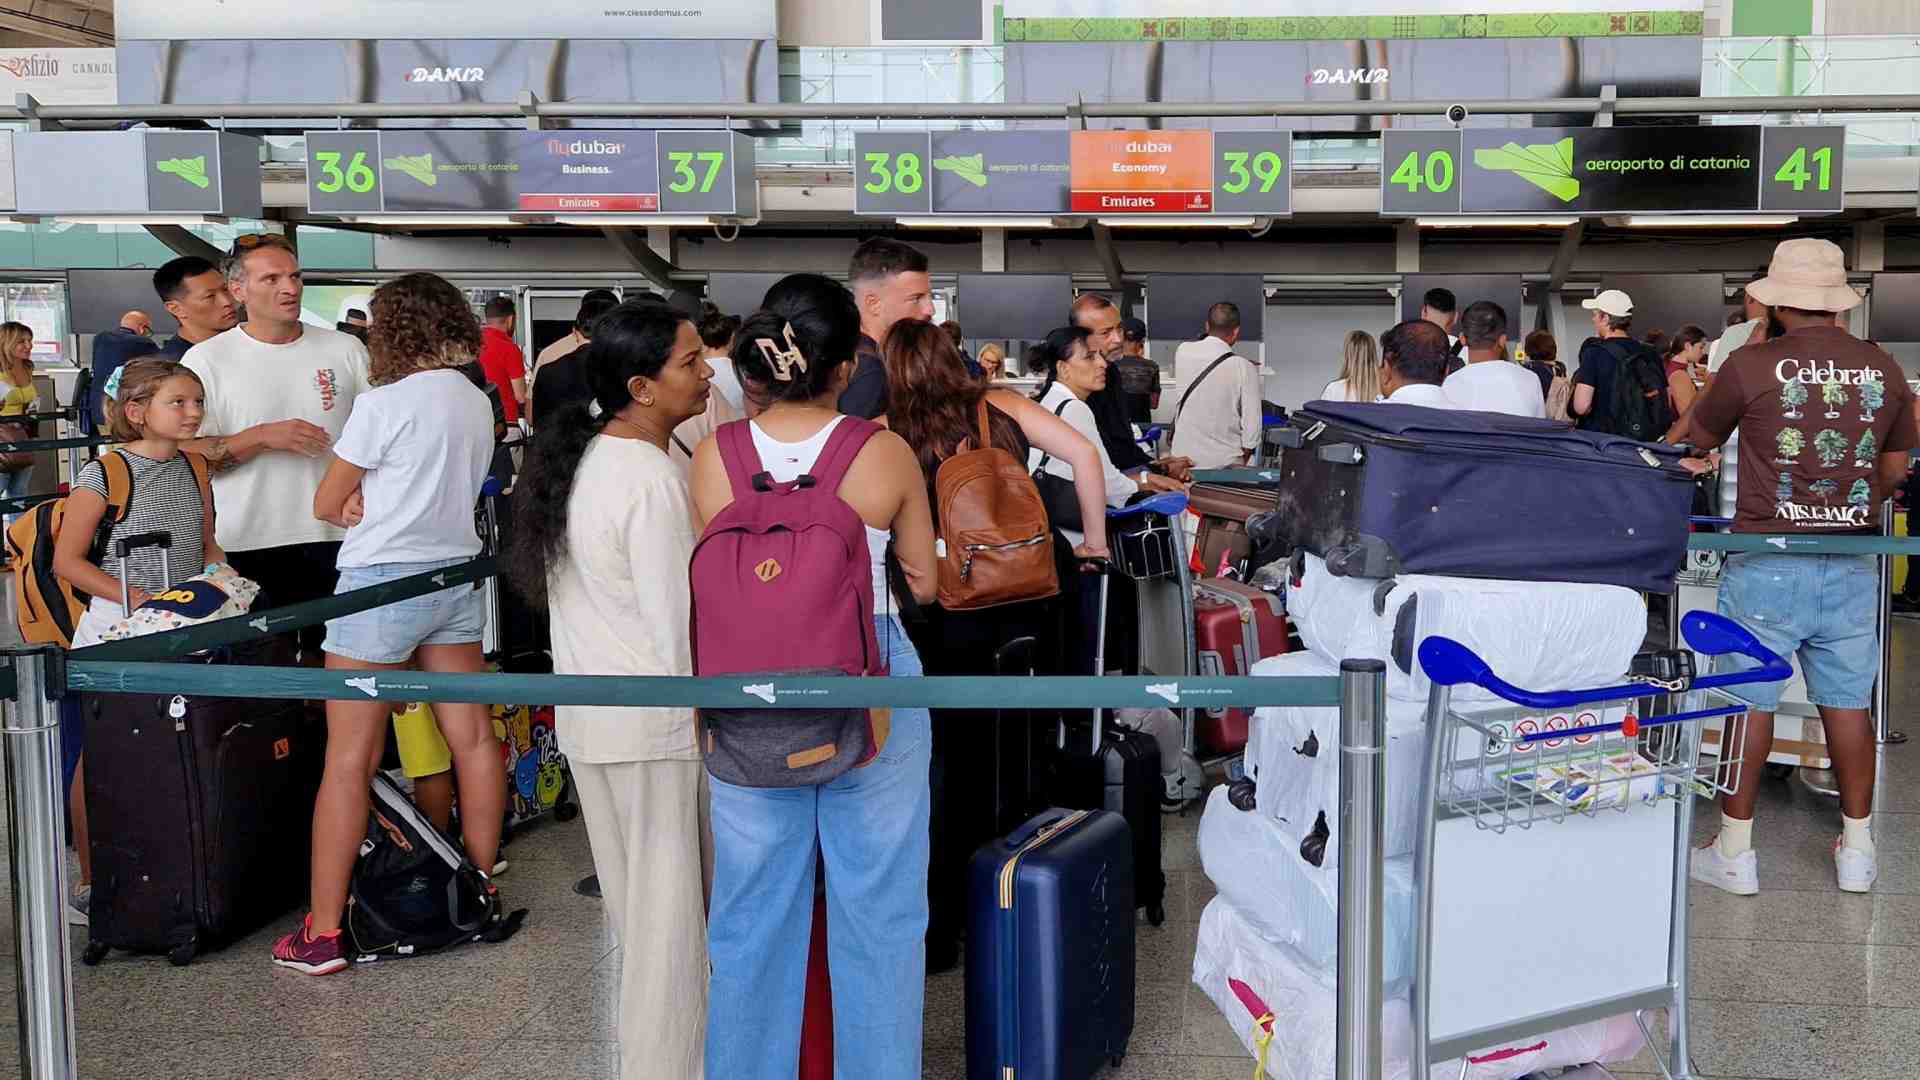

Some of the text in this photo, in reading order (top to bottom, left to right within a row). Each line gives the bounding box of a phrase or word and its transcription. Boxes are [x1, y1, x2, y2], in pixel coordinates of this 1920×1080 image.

[412, 67, 485, 82] DAMIR
[1312, 68, 1390, 84] DAMIR
[316, 152, 376, 193] 36
[668, 152, 724, 193] 37
[864, 152, 922, 193] 38
[1111, 162, 1168, 175] Economy
[1221, 151, 1282, 193] 39
[1390, 150, 1454, 193] 40
[1585, 155, 1751, 175] aeroporto di catania
[1775, 147, 1832, 191] 41
[559, 198, 601, 208] Emirates
[1101, 195, 1156, 208] Emirates
[1775, 358, 1885, 385] Celebrate
